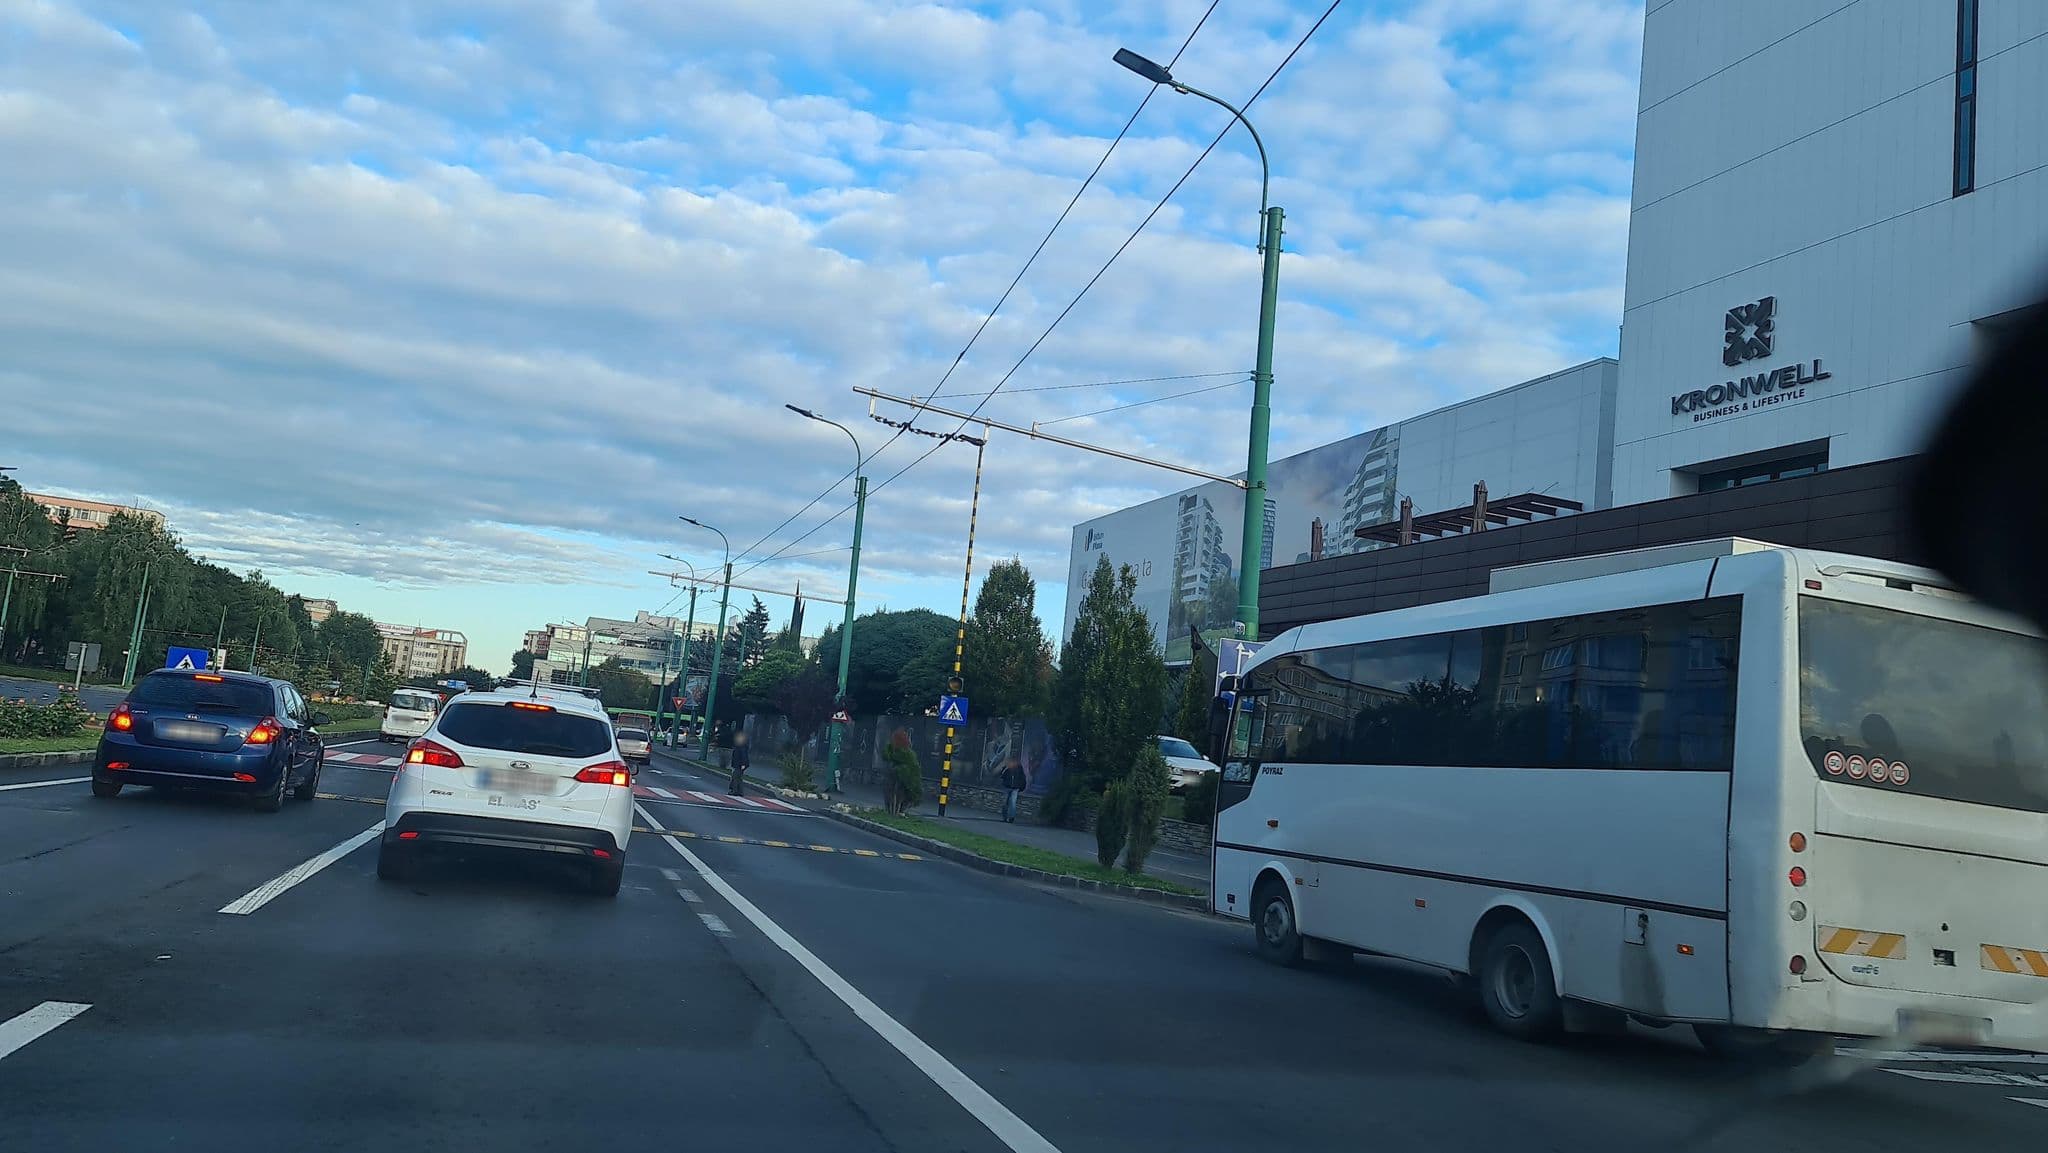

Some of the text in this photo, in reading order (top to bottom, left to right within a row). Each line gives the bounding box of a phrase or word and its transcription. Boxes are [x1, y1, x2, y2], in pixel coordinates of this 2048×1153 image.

[1671, 359, 1831, 415] KRONWELL
[1694, 389, 1805, 422] BUSINESS & LIFESTYLE
[1261, 766, 1284, 776] POYRAZ
